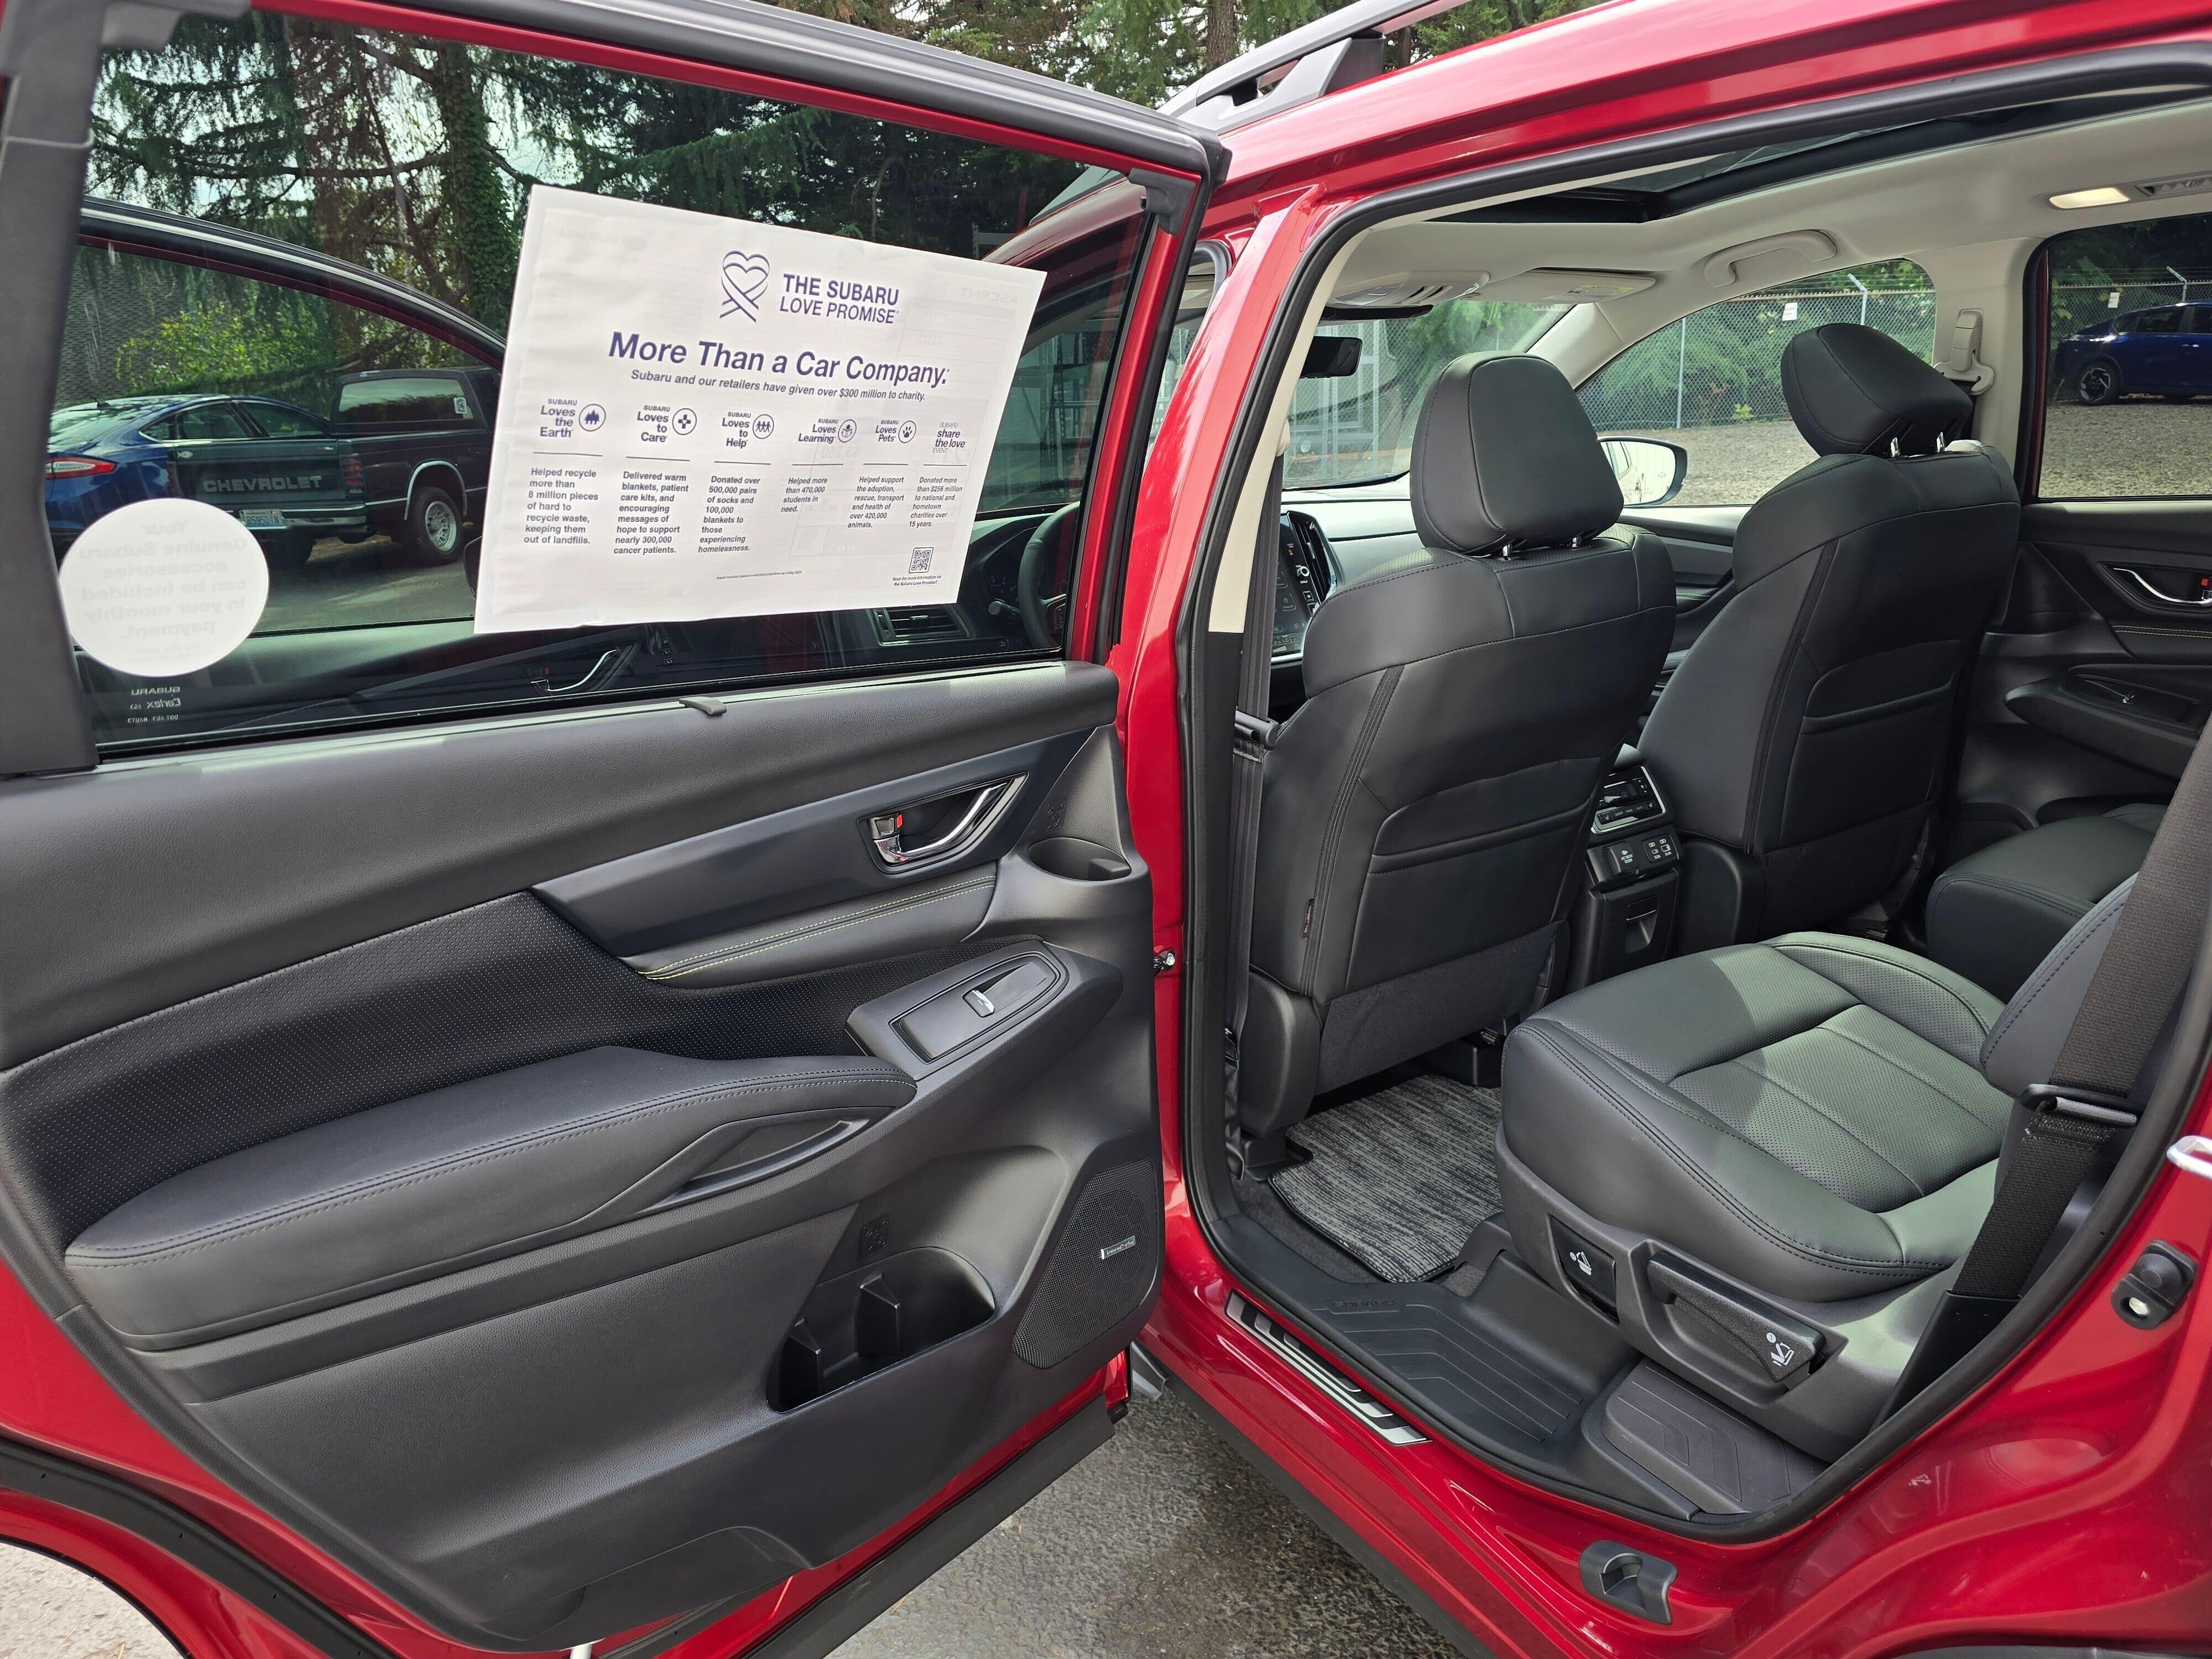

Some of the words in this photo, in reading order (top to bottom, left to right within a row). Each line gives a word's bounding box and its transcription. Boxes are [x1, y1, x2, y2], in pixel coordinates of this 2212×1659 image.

[784, 273, 821, 296] THE
[827, 280, 899, 306] SUBARU
[780, 296, 823, 316] LOVE
[608, 331, 687, 364] More
[699, 340, 764, 371] Than
[772, 355, 787, 373] a
[796, 351, 841, 378] Car
[631, 369, 671, 382] Subaru
[675, 375, 695, 384] and
[698, 377, 717, 386] our
[719, 379, 760, 390] retailers
[763, 381, 786, 392] have
[789, 384, 814, 395] given
[817, 388, 837, 397] over
[839, 388, 858, 398] $300
[860, 390, 886, 399] million
[889, 391, 896, 399] to
[898, 393, 925, 403] charity.
[541, 405, 576, 416] Loves
[637, 411, 669, 422] Loves
[555, 417, 573, 427] the
[722, 418, 750, 428] Loves
[540, 427, 571, 437] Earth
[657, 424, 667, 432] to
[812, 424, 836, 433] Loves
[641, 432, 665, 442] Care
[799, 433, 834, 444] Learning
[937, 429, 961, 438] share
[726, 438, 747, 448] Help
[935, 439, 948, 447] the
[949, 439, 966, 448] love
[531, 468, 562, 477] Helped
[565, 469, 596, 478] recycle
[623, 471, 662, 480] Delivered
[202, 476, 322, 492] CHEVROLET
[622, 482, 659, 492] blankets,
[709, 486, 738, 494] 500,000
[529, 490, 534, 498] 8
[570, 492, 598, 501] pieces
[640, 494, 657, 502] kits,
[539, 502, 560, 510] hard
[619, 505, 670, 513] encouraging
[526, 514, 559, 523] recycle
[525, 525, 561, 534] keeping
[617, 526, 637, 534] hope
[615, 536, 640, 545] nearly
[700, 535, 745, 544] experiencing
[643, 546, 676, 555] patients.
